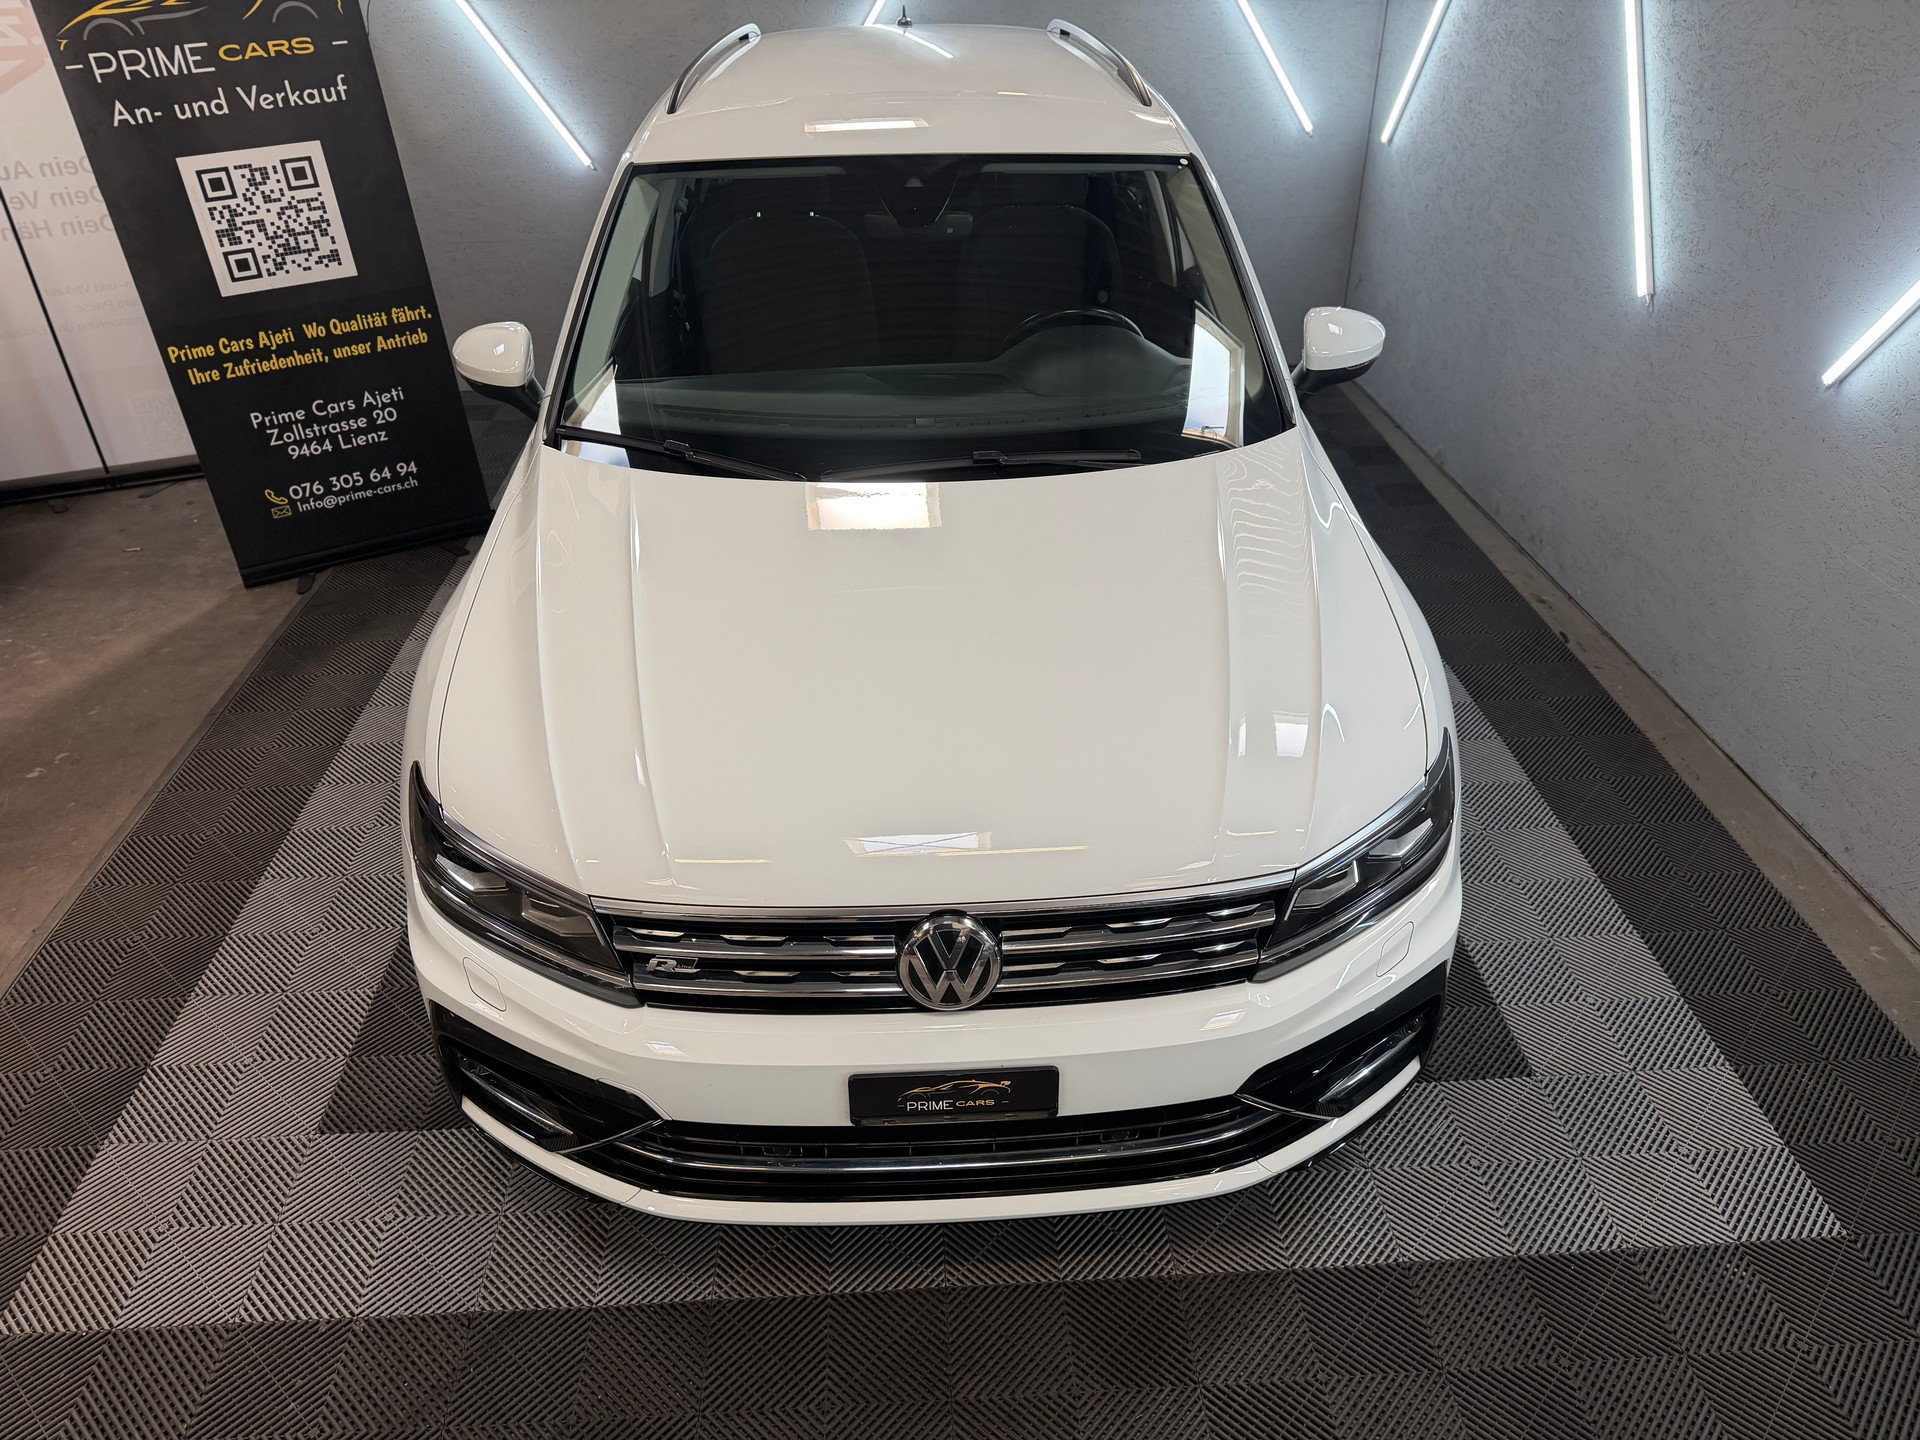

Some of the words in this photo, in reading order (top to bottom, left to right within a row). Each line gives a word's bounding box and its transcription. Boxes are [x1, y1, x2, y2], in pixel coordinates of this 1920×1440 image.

[87, 42, 215, 83] PRIME
[218, 37, 315, 61] CARS
[113, 100, 163, 127] An-
[174, 87, 230, 119] und
[236, 74, 348, 112] Verkauf
[167, 344, 215, 364] Prime
[218, 338, 255, 354] Cars
[258, 327, 295, 350] Ajeti
[303, 323, 327, 339] Wo
[329, 313, 388, 336] Qualität
[391, 305, 432, 324] fährt.
[187, 367, 221, 385] Ihre
[224, 348, 329, 379] Zufriedenheit,
[332, 341, 372, 359] unser
[376, 328, 428, 352] Antrieb
[249, 409, 306, 429] Prime
[311, 400, 356, 417] Cars
[362, 387, 405, 408] Ajeti
[265, 418, 368, 446] Zollstrasse
[372, 407, 397, 425] 20
[287, 438, 334, 460] 9464
[338, 430, 389, 450] Lienz
[288, 481, 324, 500] 076
[329, 472, 364, 491] 305
[369, 465, 392, 482] 64
[396, 460, 418, 476] 94
[297, 475, 419, 513] Info@prime-cars.ch
[906, 1100, 954, 1112] PRIME
[955, 1099, 995, 1107] CARS
